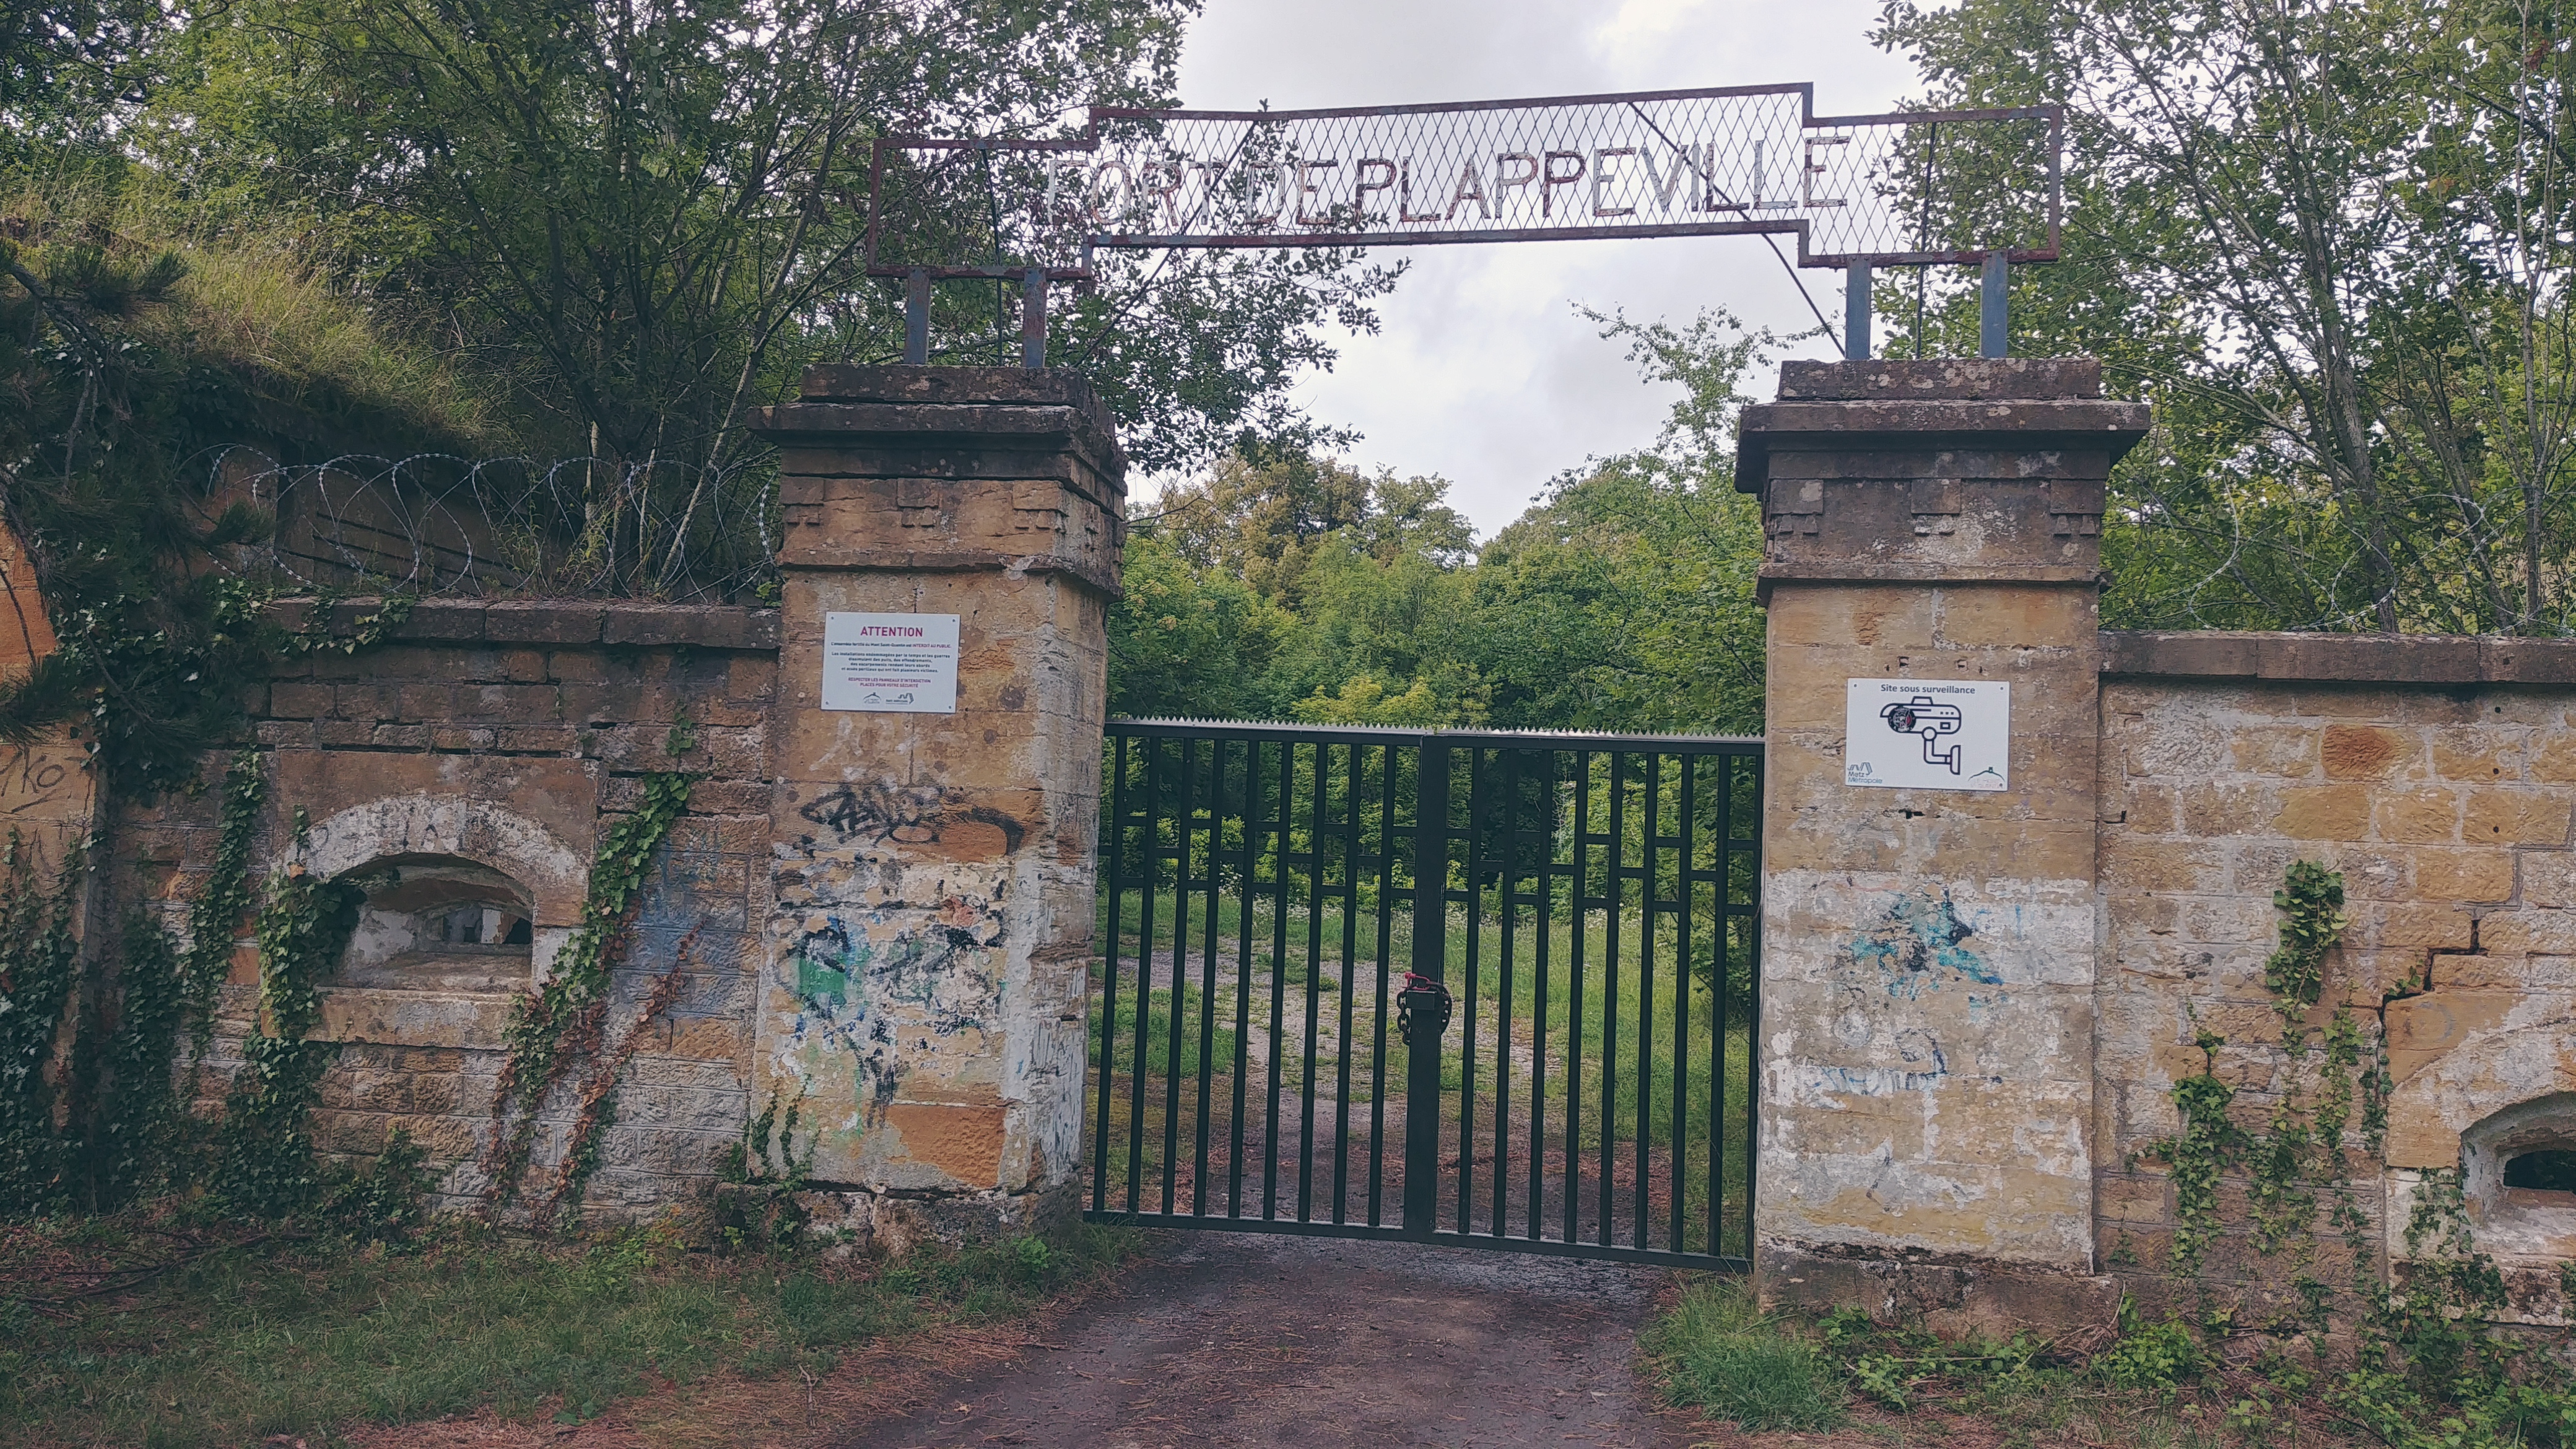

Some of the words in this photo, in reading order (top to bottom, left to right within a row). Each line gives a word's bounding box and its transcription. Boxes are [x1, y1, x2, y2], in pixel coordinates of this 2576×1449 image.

[1048, 160, 1229, 226] FORT
[1245, 159, 1338, 225] DE
[1355, 136, 1850, 224] PLAPPEVILLE
[860, 626, 923, 637] ATTENTION
[1881, 684, 1897, 692] Site
[1922, 685, 1975, 694] surveillance
